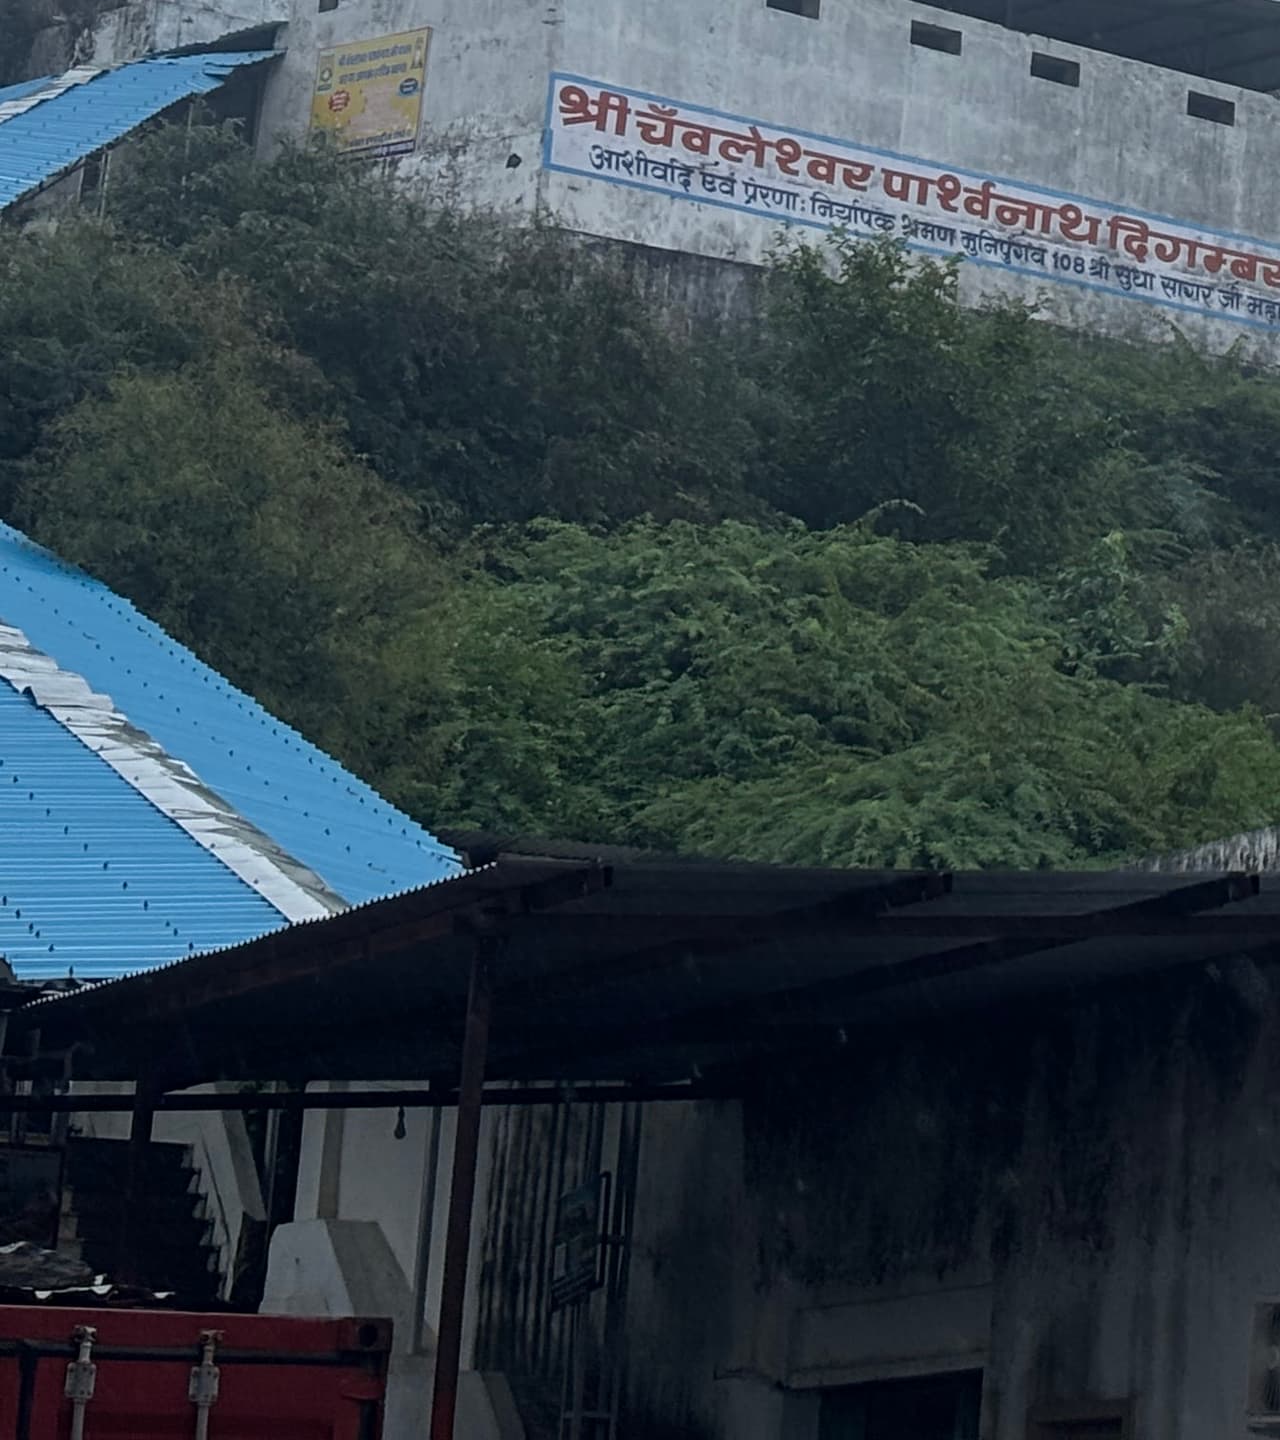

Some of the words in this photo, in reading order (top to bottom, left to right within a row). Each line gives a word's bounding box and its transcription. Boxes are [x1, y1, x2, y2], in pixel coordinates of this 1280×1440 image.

[559, 85, 631, 136] श्री
[881, 167, 1101, 245] पार्श्वनाथ
[1052, 251, 1085, 274] 108
[1088, 256, 1111, 280] श्री
[1160, 274, 1214, 308] सागर
